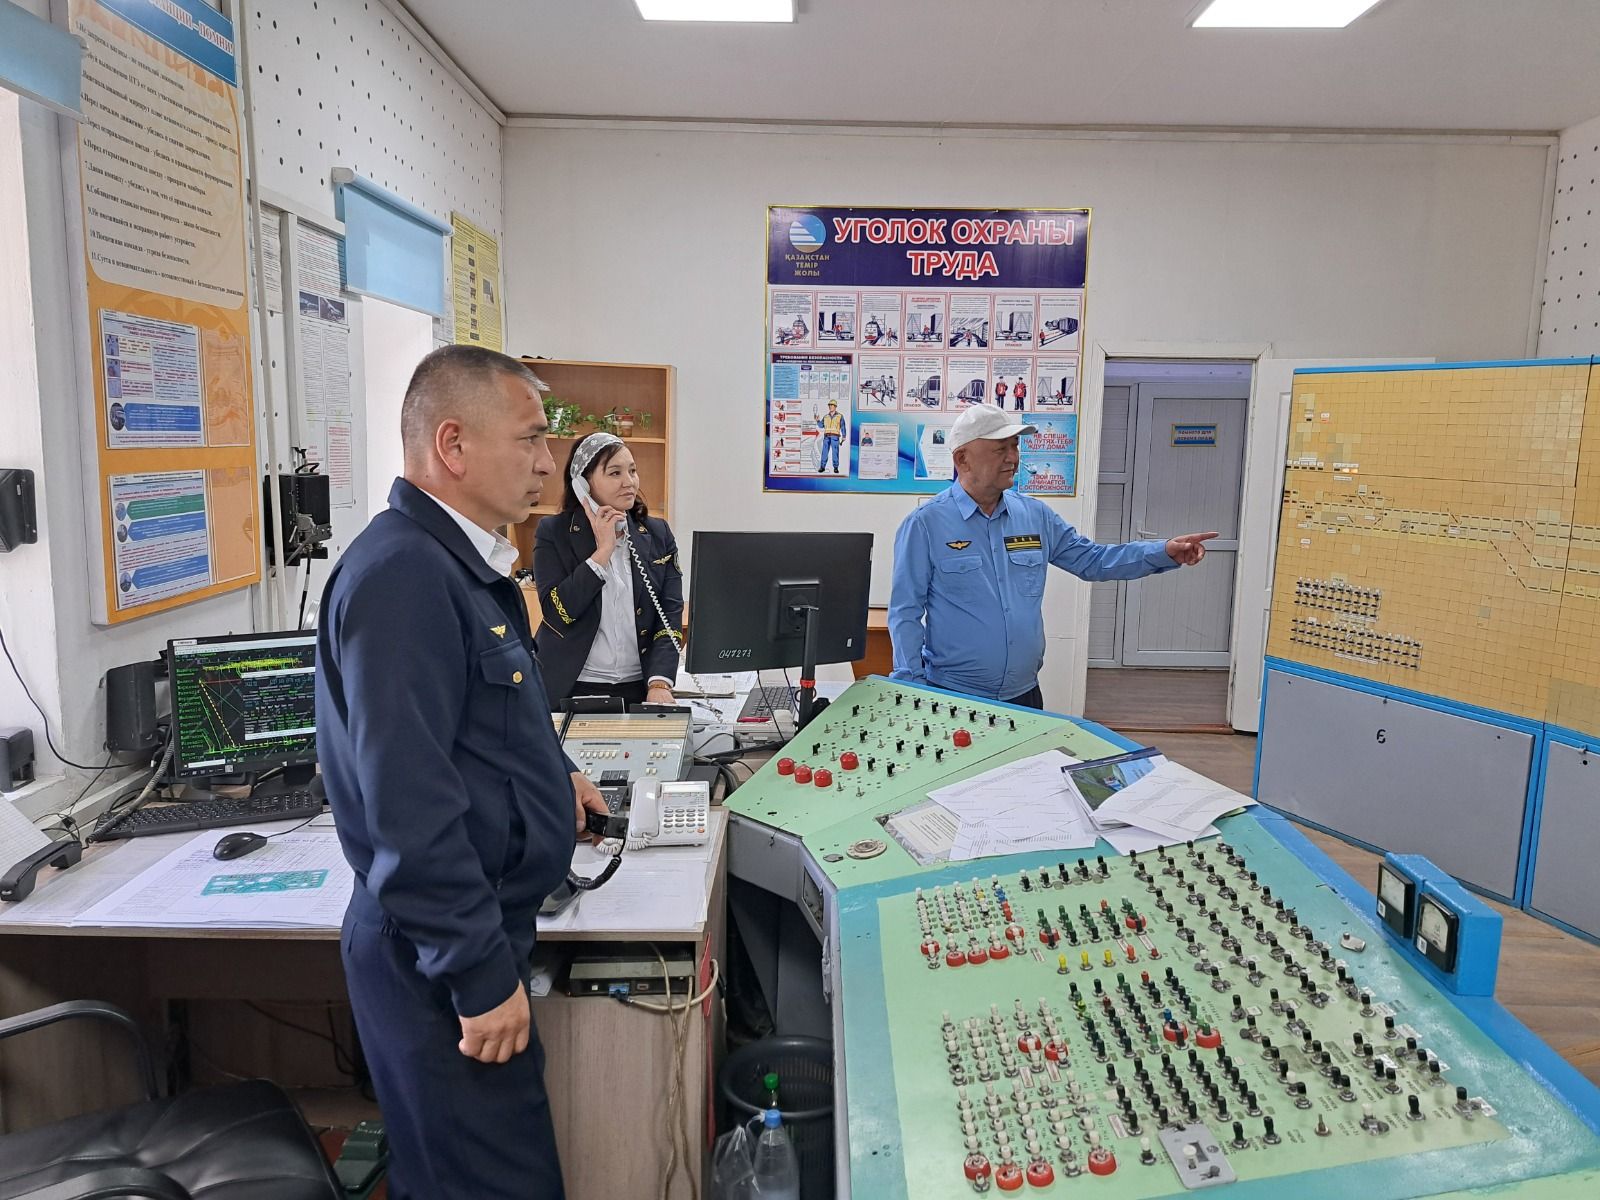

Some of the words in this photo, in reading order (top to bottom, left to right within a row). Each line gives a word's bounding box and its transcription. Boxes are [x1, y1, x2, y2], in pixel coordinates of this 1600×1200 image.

[833, 217, 947, 244] УГОЛОК
[952, 219, 1075, 246] ОХРАНЫ
[907, 250, 999, 281] ТРУДА
[718, 649, 752, 659] 047273
[1376, 728, 1386, 744] 6
